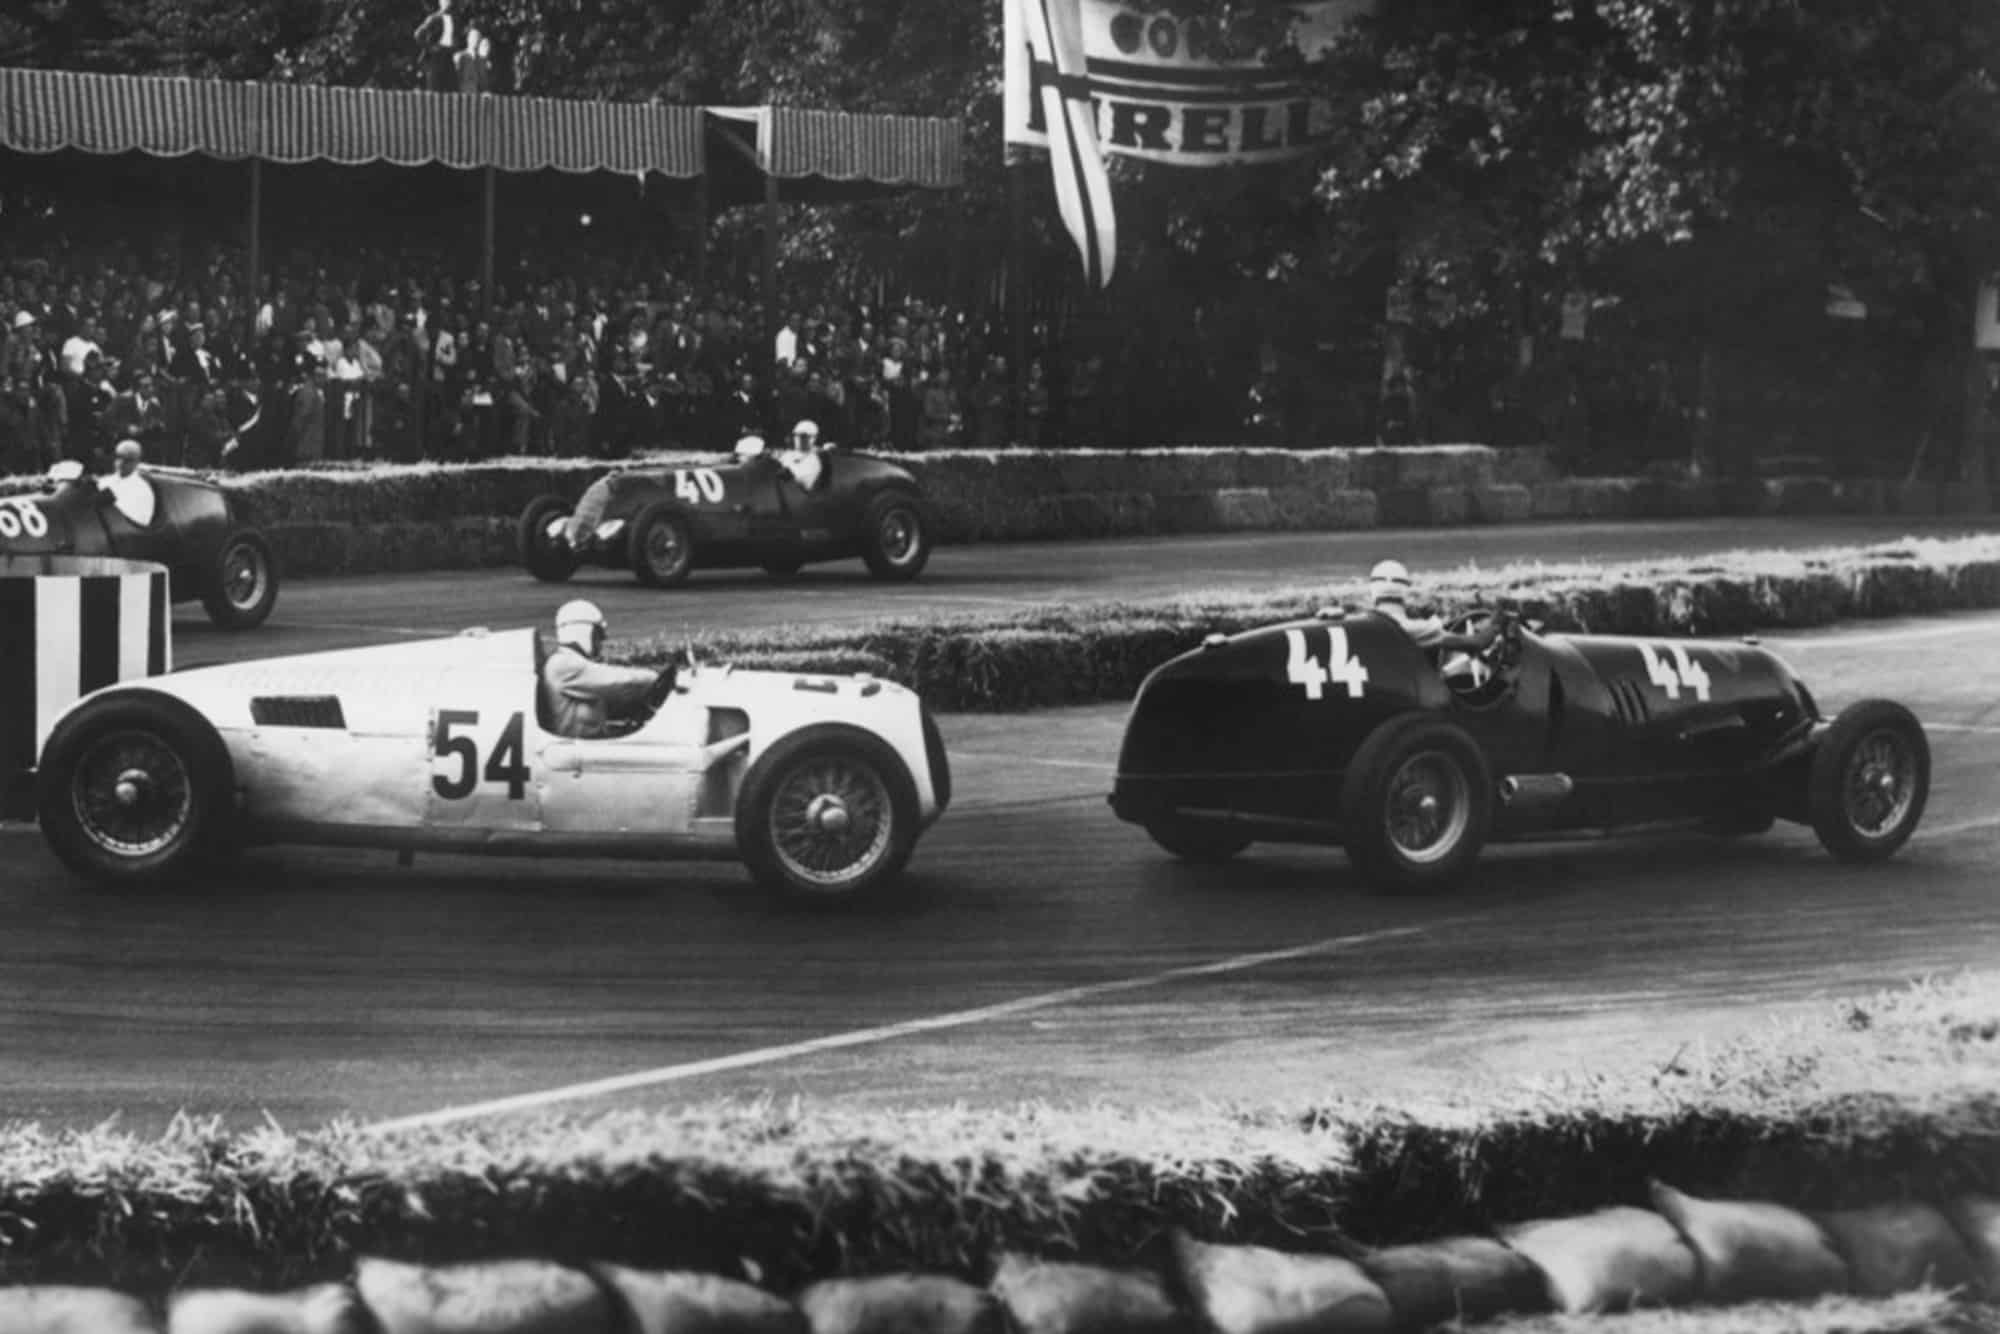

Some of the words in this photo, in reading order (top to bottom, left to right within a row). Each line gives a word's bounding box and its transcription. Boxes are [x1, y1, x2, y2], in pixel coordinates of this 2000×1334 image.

[674, 469, 725, 504] 40
[1285, 626, 1368, 699] 44
[1636, 643, 1711, 701] 44
[431, 709, 531, 800] 54
